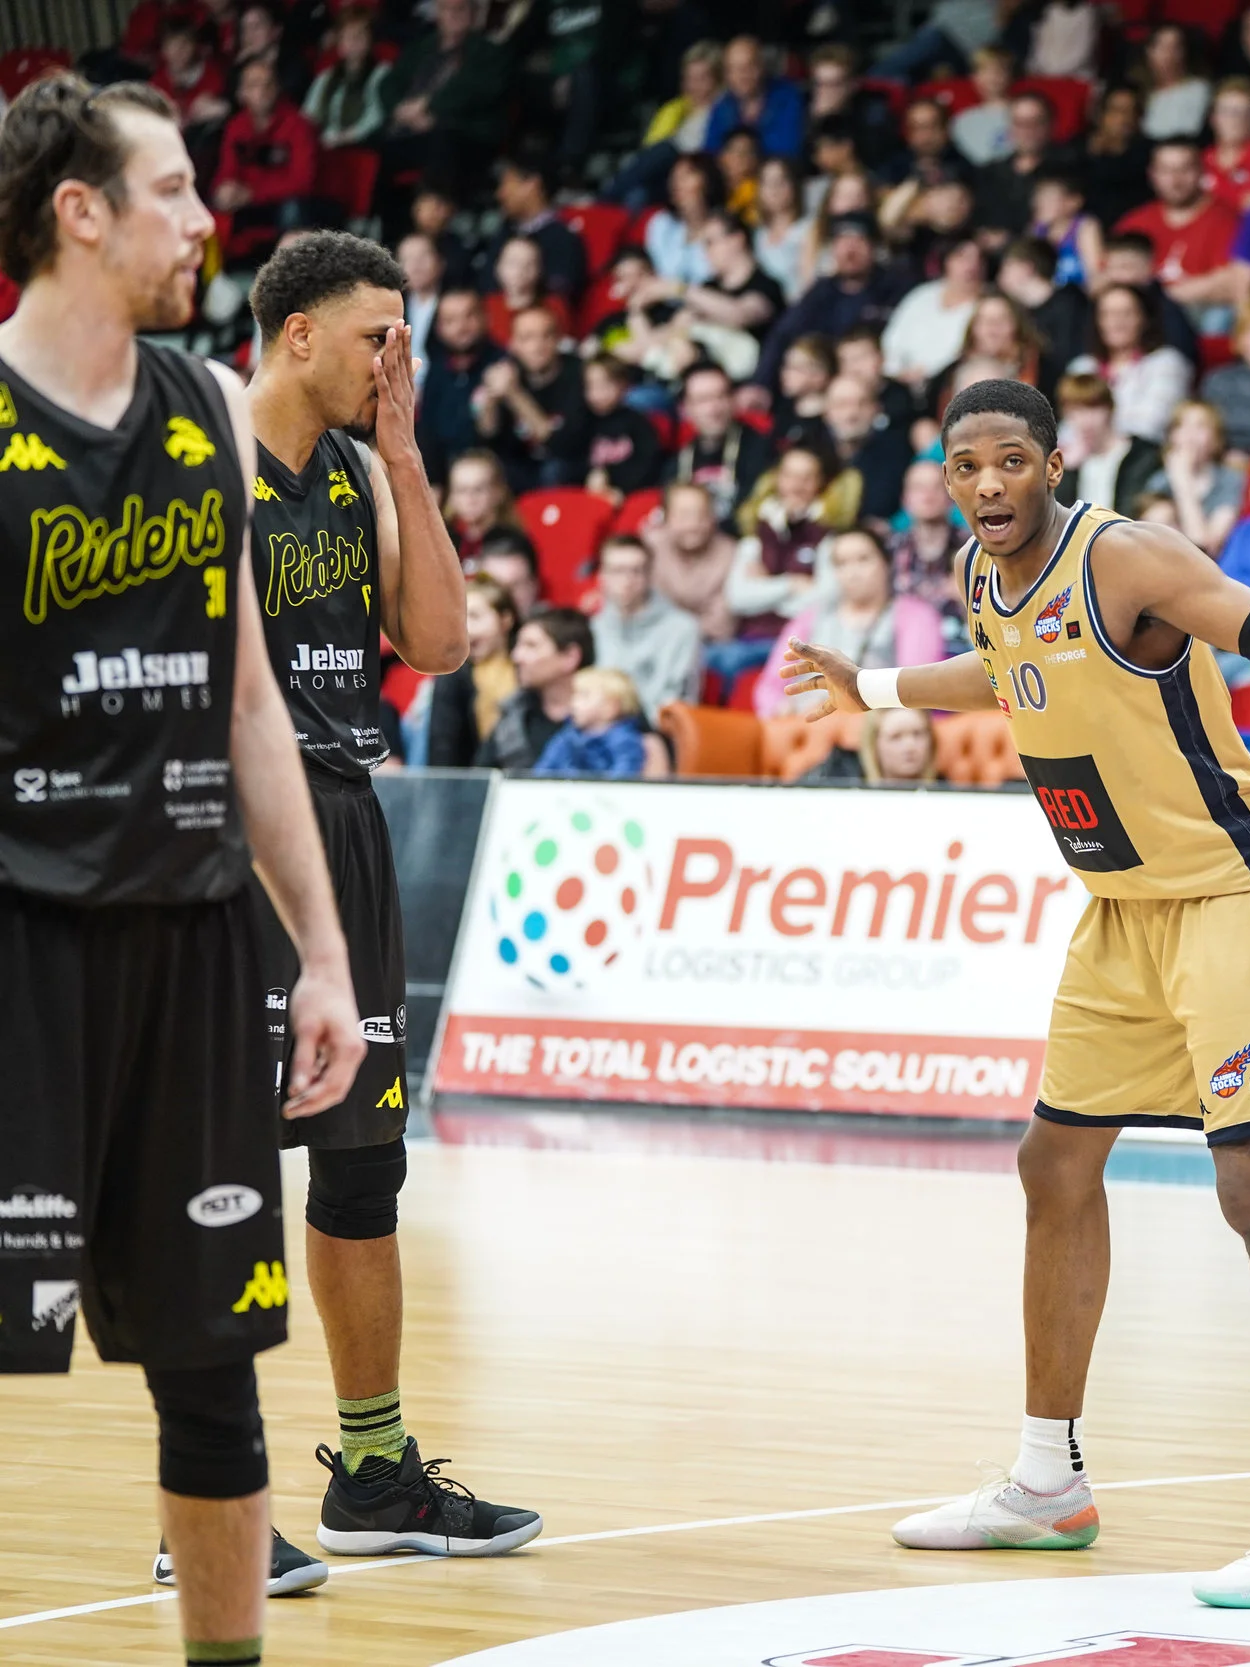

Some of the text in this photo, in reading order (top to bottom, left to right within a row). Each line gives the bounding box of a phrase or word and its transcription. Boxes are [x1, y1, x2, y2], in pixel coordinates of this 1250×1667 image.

[24, 488, 226, 625] Riders
[265, 526, 369, 617] Riders
[1035, 620, 1061, 637] ROCKS
[61, 647, 209, 694] Jelson
[290, 673, 367, 690] HOMES
[1006, 661, 1047, 713] 10
[60, 685, 212, 717] HOMES
[1037, 786, 1099, 830] RED
[1063, 836, 1105, 854] Radisson
[657, 834, 1068, 945] Premier
[644, 946, 961, 990] LOGISTICS GROUP
[461, 1033, 1029, 1097] THE TOTAL LOGISTIC SOLUTION
[1211, 1074, 1243, 1093] ROCKS
